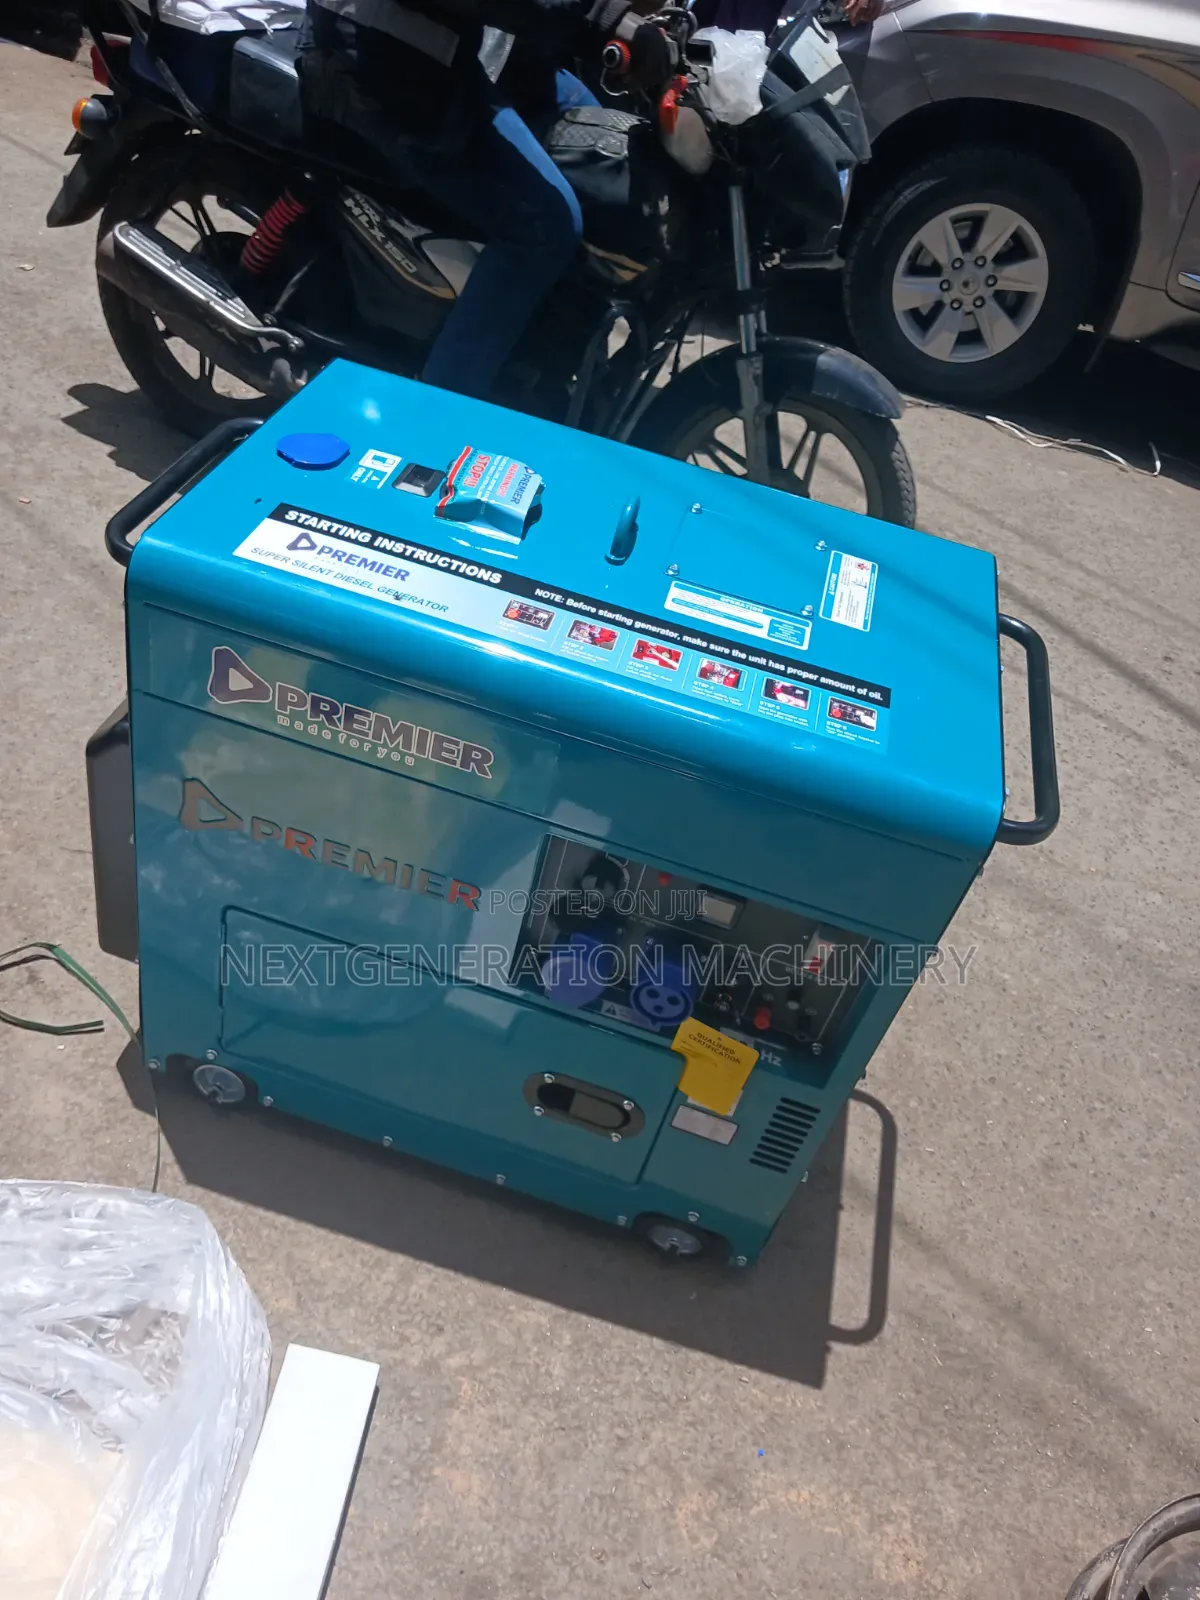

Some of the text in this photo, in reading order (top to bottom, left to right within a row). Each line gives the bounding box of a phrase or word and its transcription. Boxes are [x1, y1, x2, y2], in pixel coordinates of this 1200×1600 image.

[510, 473, 532, 504] PREMIER
[285, 510, 502, 584] STARTING INSTRUCTIONS
[317, 545, 410, 581] PREMIER
[251, 547, 449, 613] SUPER SILENT DIESEL GENERATOR
[720, 596, 764, 613] OPERATION
[534, 588, 884, 701] NOTE: Before starting generator, make sure the unit has proper amount of oil.
[275, 682, 494, 779] PREMIER
[251, 816, 481, 911] PREMIER
[688, 1033, 741, 1065] CERTIFICATION
[696, 1032, 736, 1056] QUALIFIED
[760, 1049, 782, 1067] Hz
